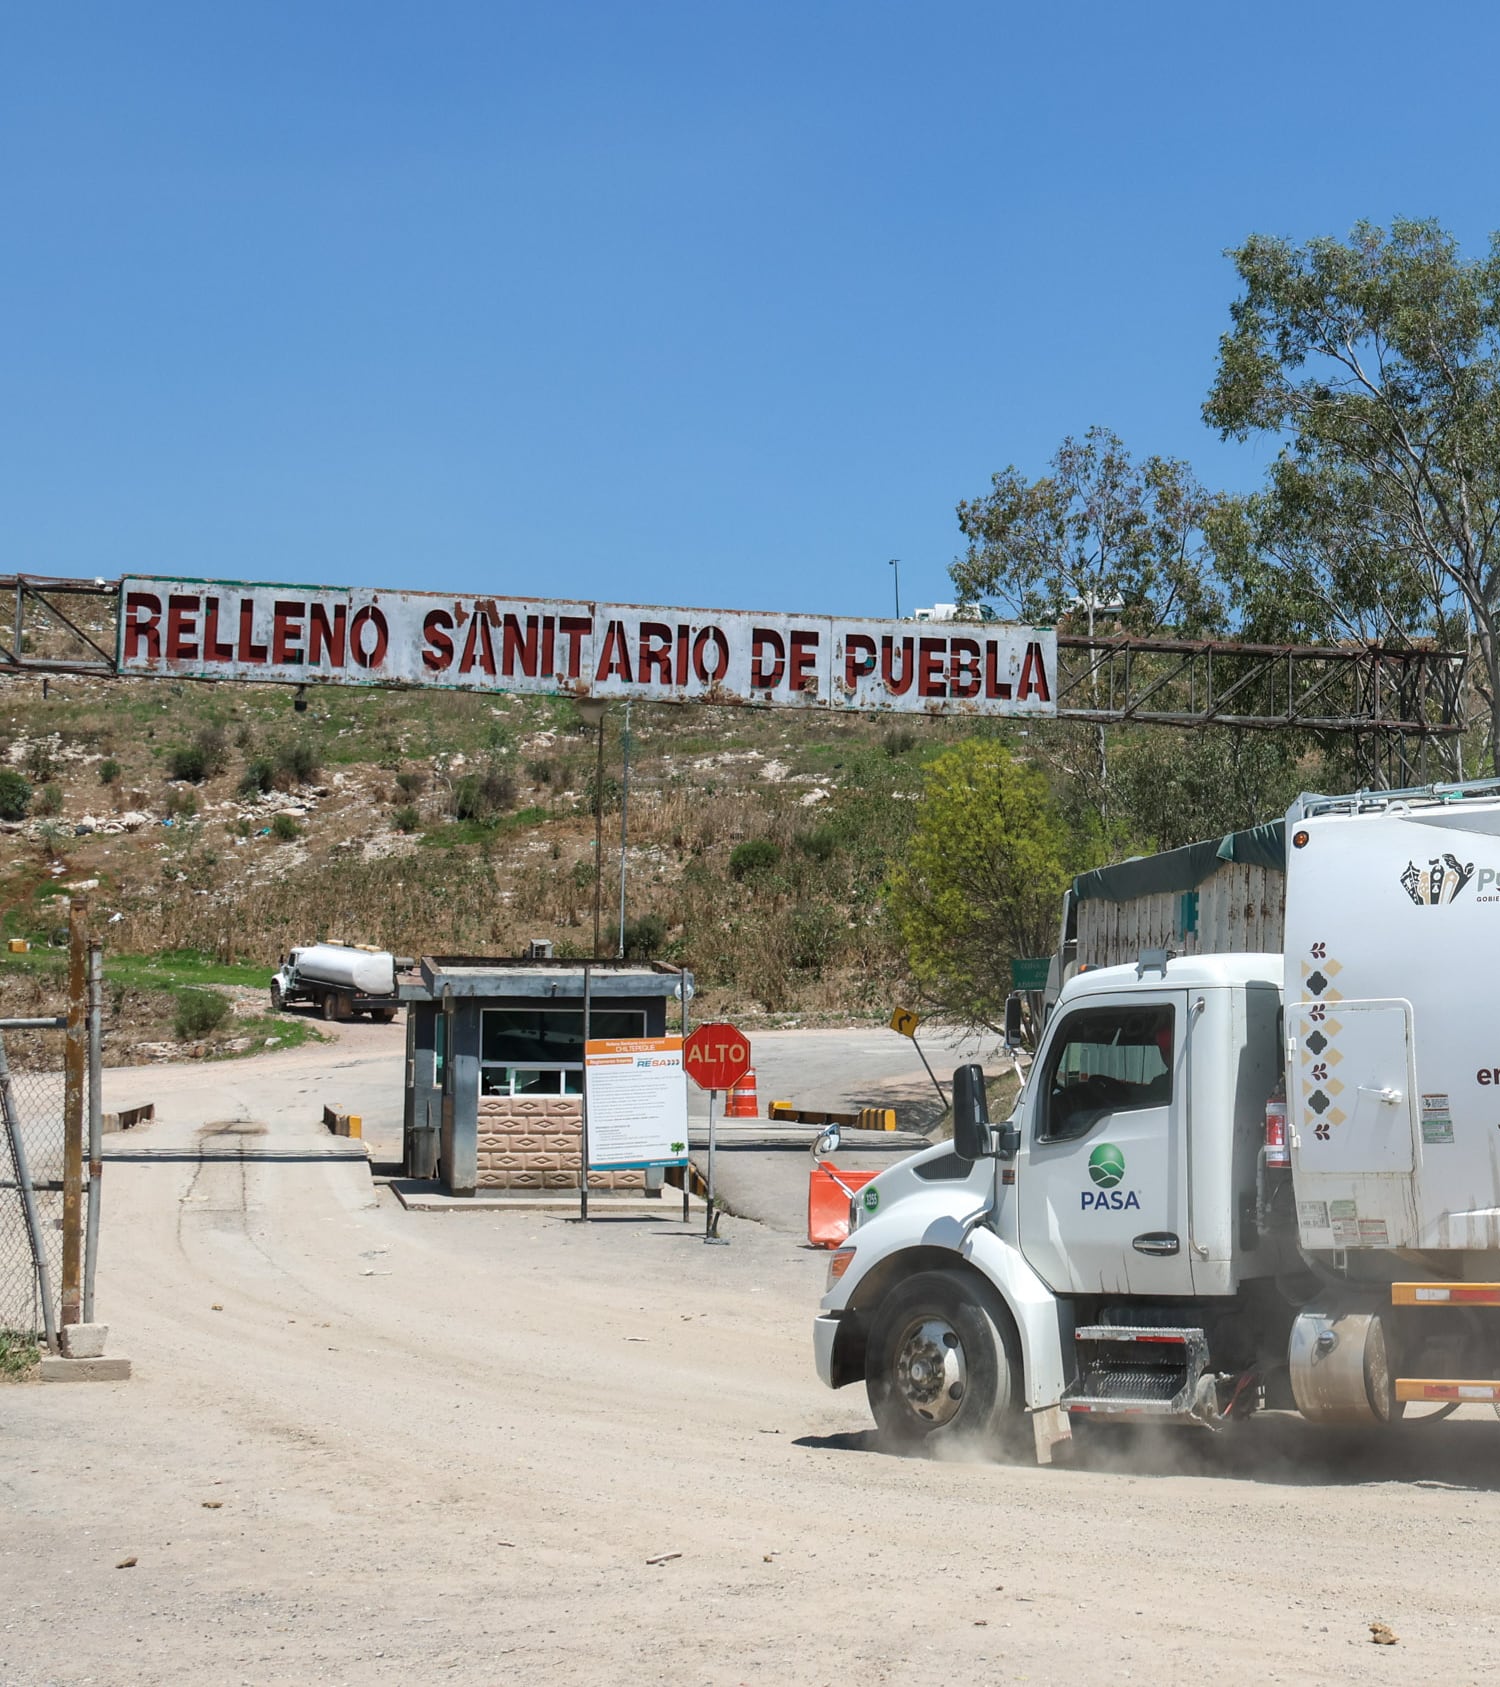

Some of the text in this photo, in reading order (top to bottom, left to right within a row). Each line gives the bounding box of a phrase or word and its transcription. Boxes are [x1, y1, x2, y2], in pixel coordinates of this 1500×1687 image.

[124, 592, 1050, 702] RELLENO SANITARIO DE PUEBLA
[687, 1043, 746, 1063] ALTO
[636, 1059, 667, 1068] RESA
[1081, 1190, 1141, 1210] PASA
